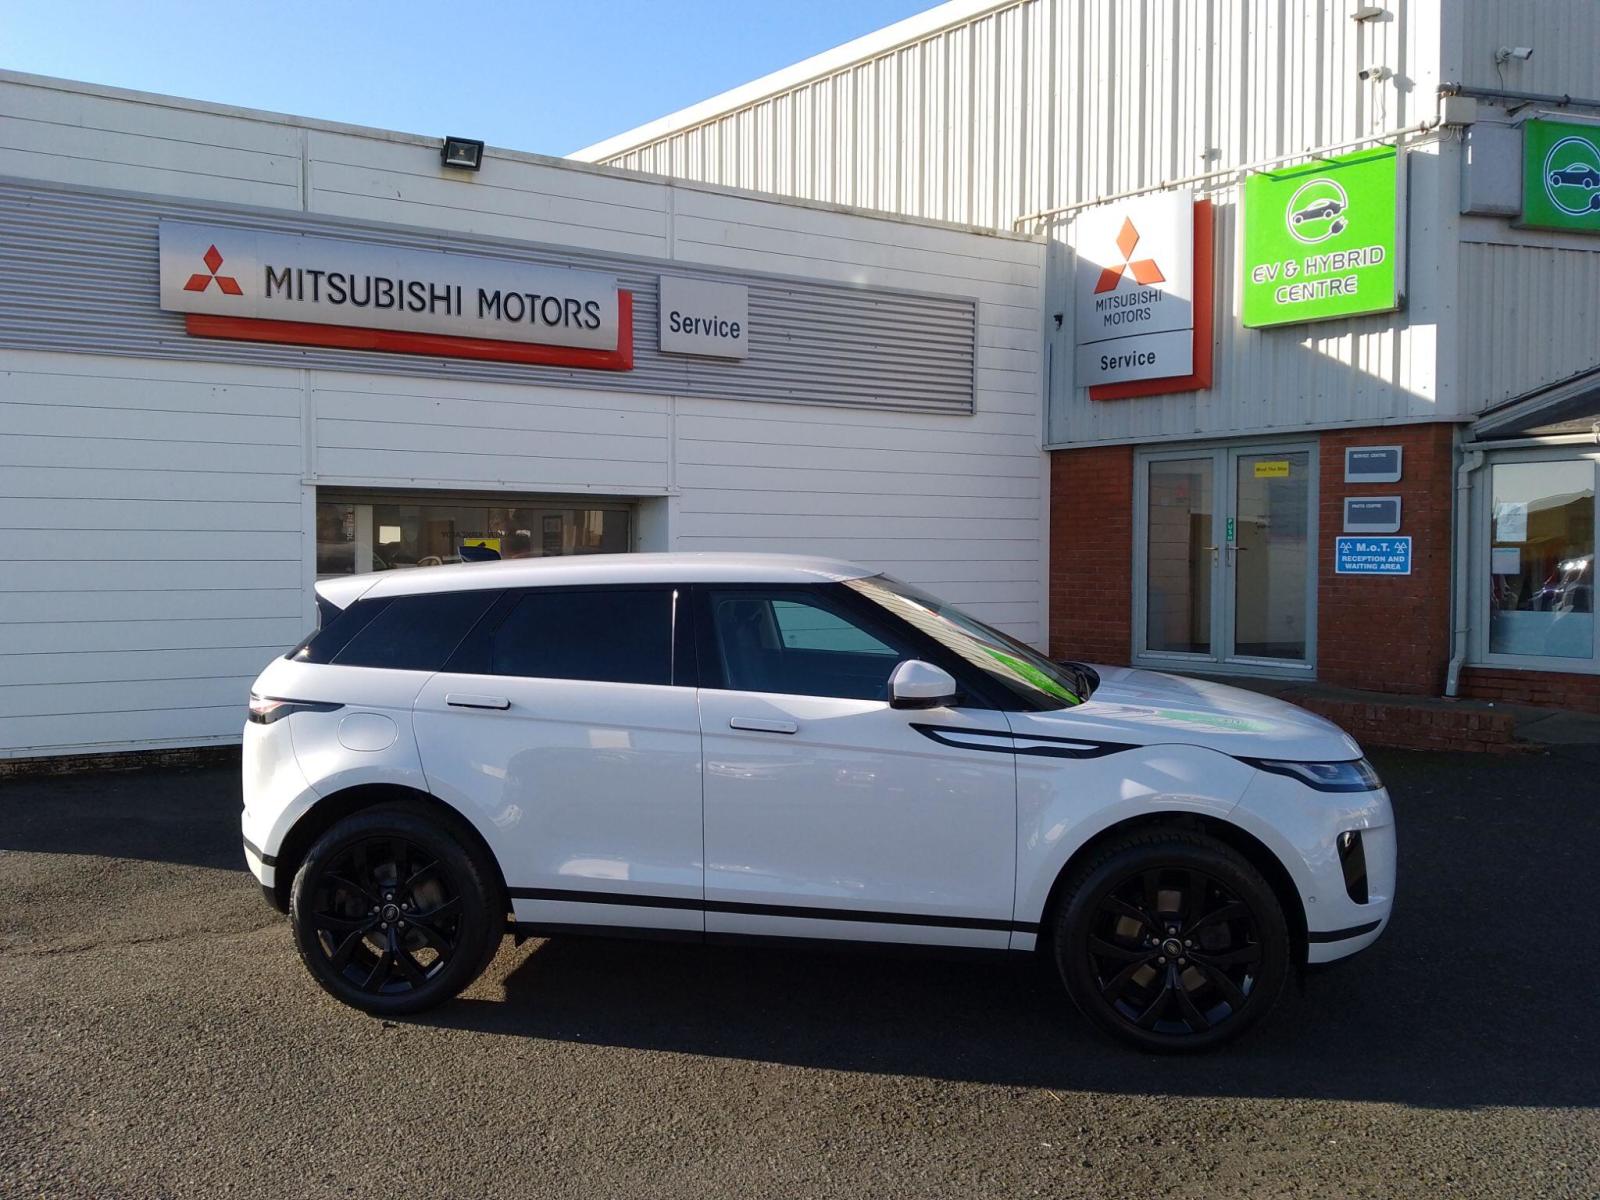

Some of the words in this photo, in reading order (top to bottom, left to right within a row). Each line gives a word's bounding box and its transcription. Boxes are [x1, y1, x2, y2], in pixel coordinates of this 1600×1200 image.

[1252, 263, 1279, 284] EV
[1284, 259, 1300, 280] &
[1304, 245, 1386, 276] HYBRID
[265, 265, 461, 316] MITSUBISHI
[478, 288, 601, 329] MOTORS
[1095, 289, 1163, 312] MITSUBISHI
[1275, 275, 1358, 304] CENTRE
[669, 310, 741, 339] Service
[1103, 307, 1152, 327] MOTORS
[1100, 350, 1156, 371] Service
[1356, 543, 1390, 552] M.o.T.
